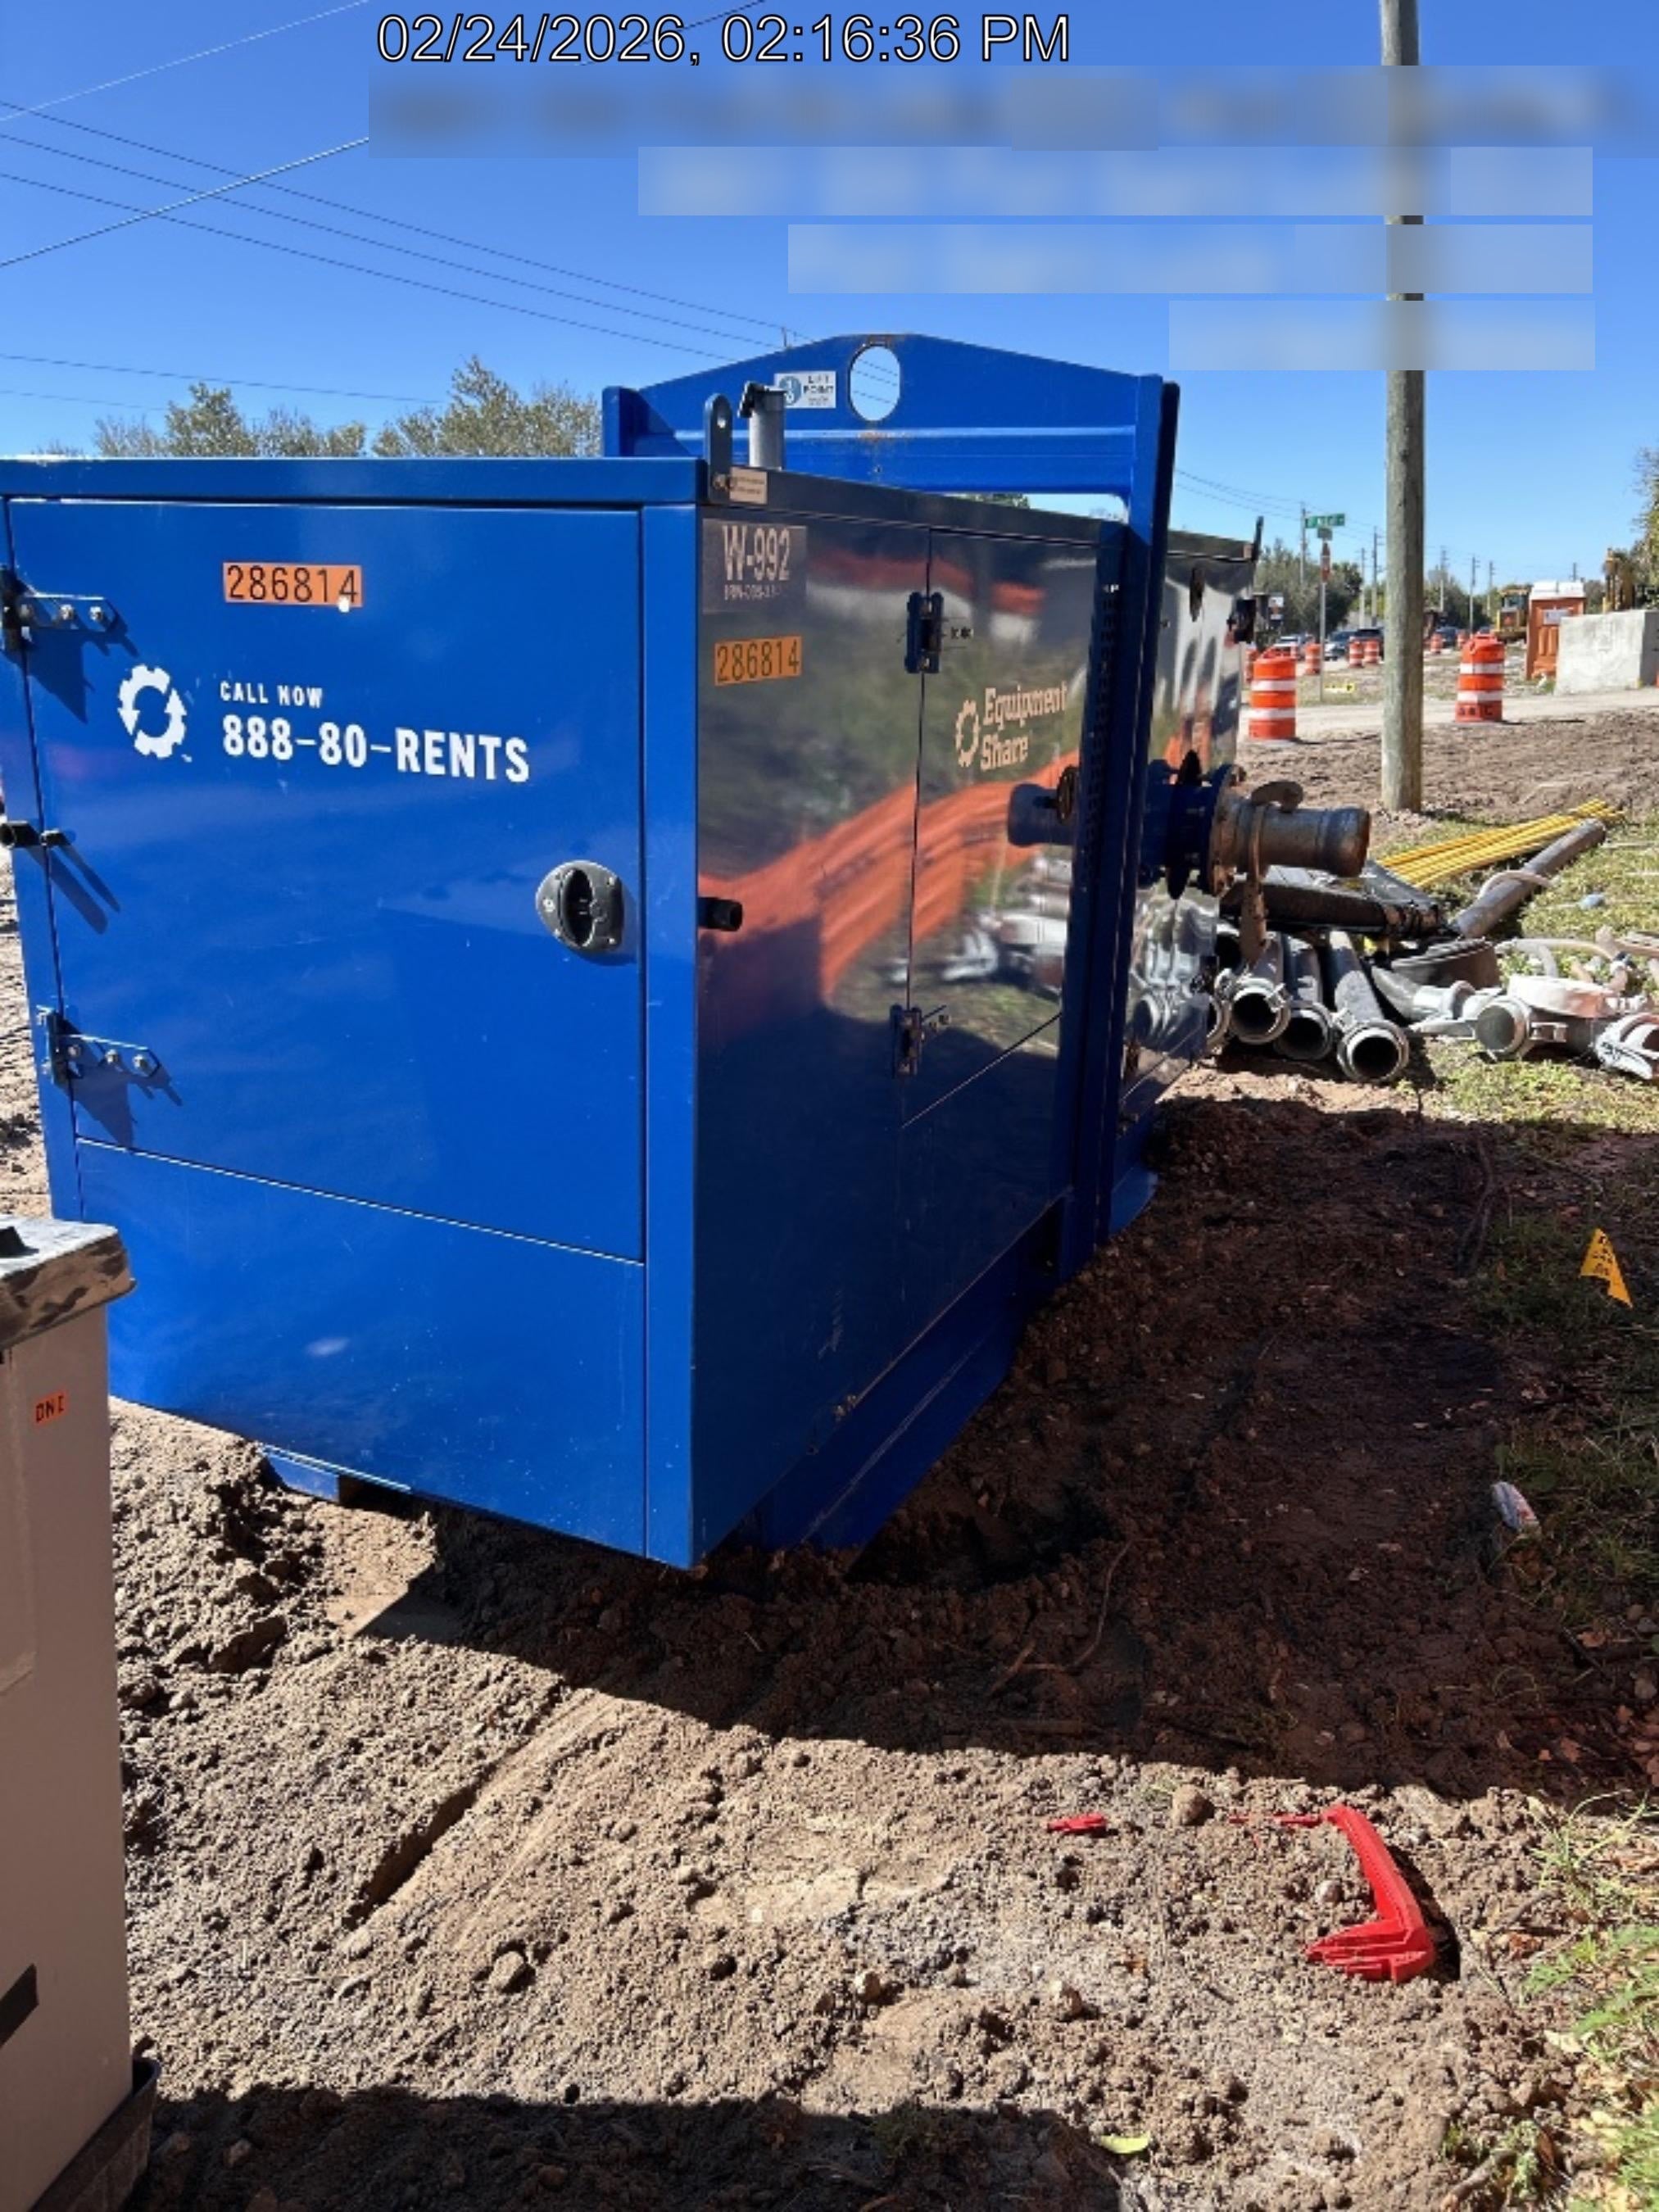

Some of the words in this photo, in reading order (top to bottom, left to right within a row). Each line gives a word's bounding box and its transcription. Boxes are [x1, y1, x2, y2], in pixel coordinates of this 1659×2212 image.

[722, 524, 791, 581] W-992
[227, 564, 358, 603] 286814
[717, 639, 800, 682] 286814
[220, 681, 269, 705] CALL
[278, 686, 324, 709] NOW
[983, 680, 1068, 731] Equipment
[222, 714, 529, 783] 888-80-RENTS
[980, 732, 1029, 772] Share
